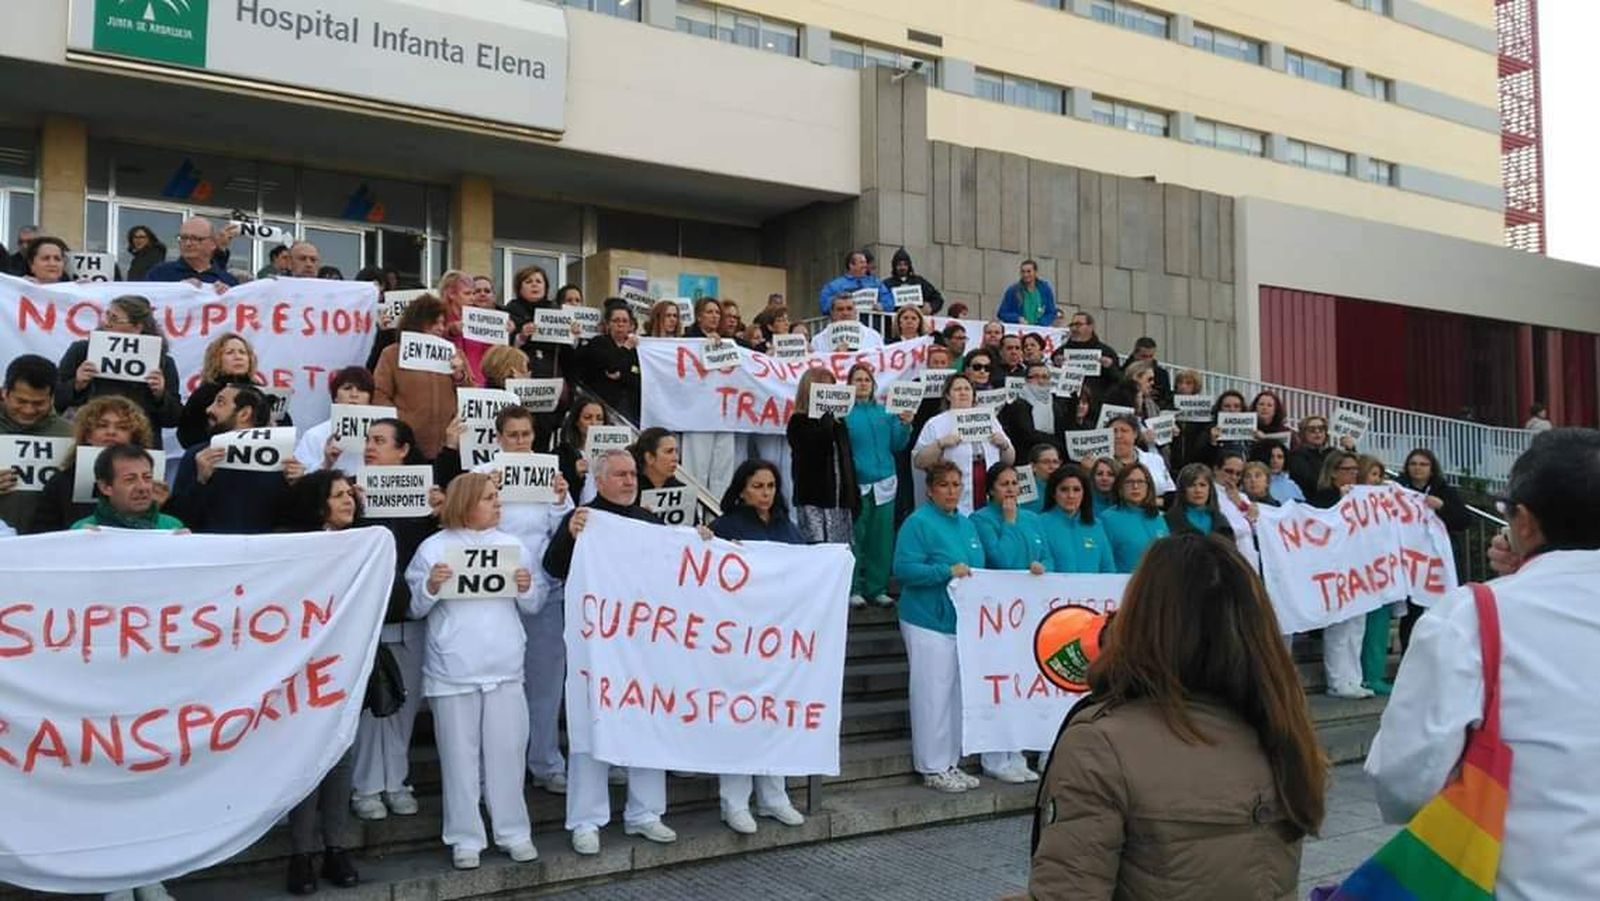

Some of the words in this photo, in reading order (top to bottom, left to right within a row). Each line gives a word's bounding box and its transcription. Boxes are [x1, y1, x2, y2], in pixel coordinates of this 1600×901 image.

[236, 0, 358, 44] Hospital
[373, 22, 464, 65] Infanta
[477, 43, 546, 80] Elena
[241, 223, 273, 238] NO
[75, 255, 101, 270] 7H
[19, 296, 101, 333] NO
[153, 302, 373, 338] UPRESION
[107, 337, 140, 354] 7H
[101, 356, 146, 377] NO
[15, 440, 54, 460] 7H
[226, 445, 280, 466] NO
[367, 475, 379, 488] NO
[380, 474, 425, 488] SUPRESION
[366, 494, 426, 508] TRANSPORTE
[656, 491, 682, 508] 7H
[1278, 517, 1331, 552] NO
[465, 549, 499, 568] 7H
[679, 546, 750, 592] NO
[457, 574, 506, 593] NO
[580, 594, 816, 662] SUPRESION
[979, 598, 1025, 638] NO
[580, 669, 826, 730] TRANSPORTE
